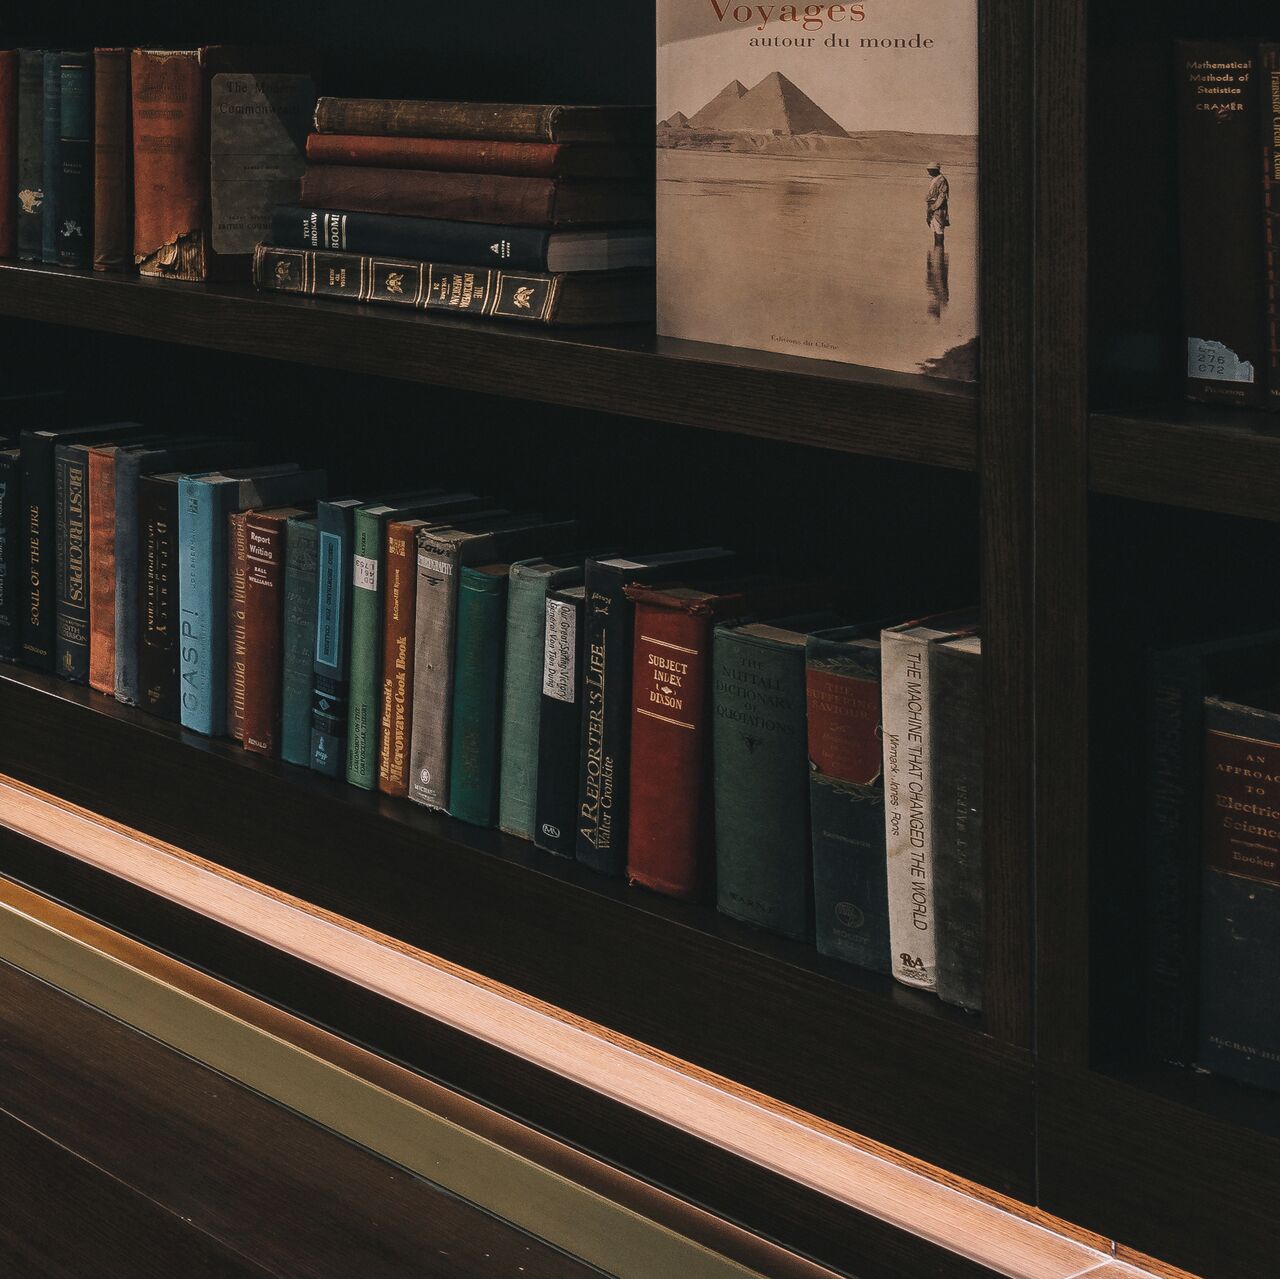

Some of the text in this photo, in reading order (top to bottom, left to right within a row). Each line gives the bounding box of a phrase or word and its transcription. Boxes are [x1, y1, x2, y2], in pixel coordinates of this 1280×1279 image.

[749, 33, 935, 49] autour du monde
[1186, 60, 1252, 70] Mathematical
[225, 81, 248, 94] The
[1190, 73, 1249, 82] Methods of
[1197, 85, 1241, 95] Statistics
[310, 212, 318, 247] BROKAW
[330, 214, 340, 249] BOOM!
[473, 286, 484, 299] THE
[1198, 353, 1226, 365] 276
[69, 466, 83, 601] BEST RECIPES
[250, 531, 271, 545] Report
[249, 544, 273, 559] Writing
[30, 505, 40, 626] SOUL OF THE FIRE
[235, 611, 245, 620] a
[549, 602, 558, 632] General
[182, 609, 199, 712] GASP!
[556, 605, 571, 699] Our Great Spring Victory
[648, 653, 688, 675] SUBJECT
[739, 657, 765, 671] THE
[547, 669, 557, 688] Dung
[653, 669, 682, 688] INDEX
[722, 664, 783, 692] NUTTALL
[649, 690, 683, 711] DIXSON
[716, 679, 795, 710] DICTIONARY
[390, 636, 407, 785] Microwave Cook Book
[716, 704, 796, 736] QUOTATIONS
[380, 679, 392, 781] Madame Benoit's
[580, 643, 604, 846] A REPORTER'S LIFE
[1246, 753, 1265, 764] AN
[1216, 763, 1280, 783] APPROAC
[906, 652, 928, 931] THE MACHINE THAT CHANGED THE WORLD
[1246, 785, 1265, 796] TO
[598, 756, 614, 849] Walter Cronkite
[1215, 794, 1280, 820] Electric
[1223, 816, 1280, 839] Scienc
